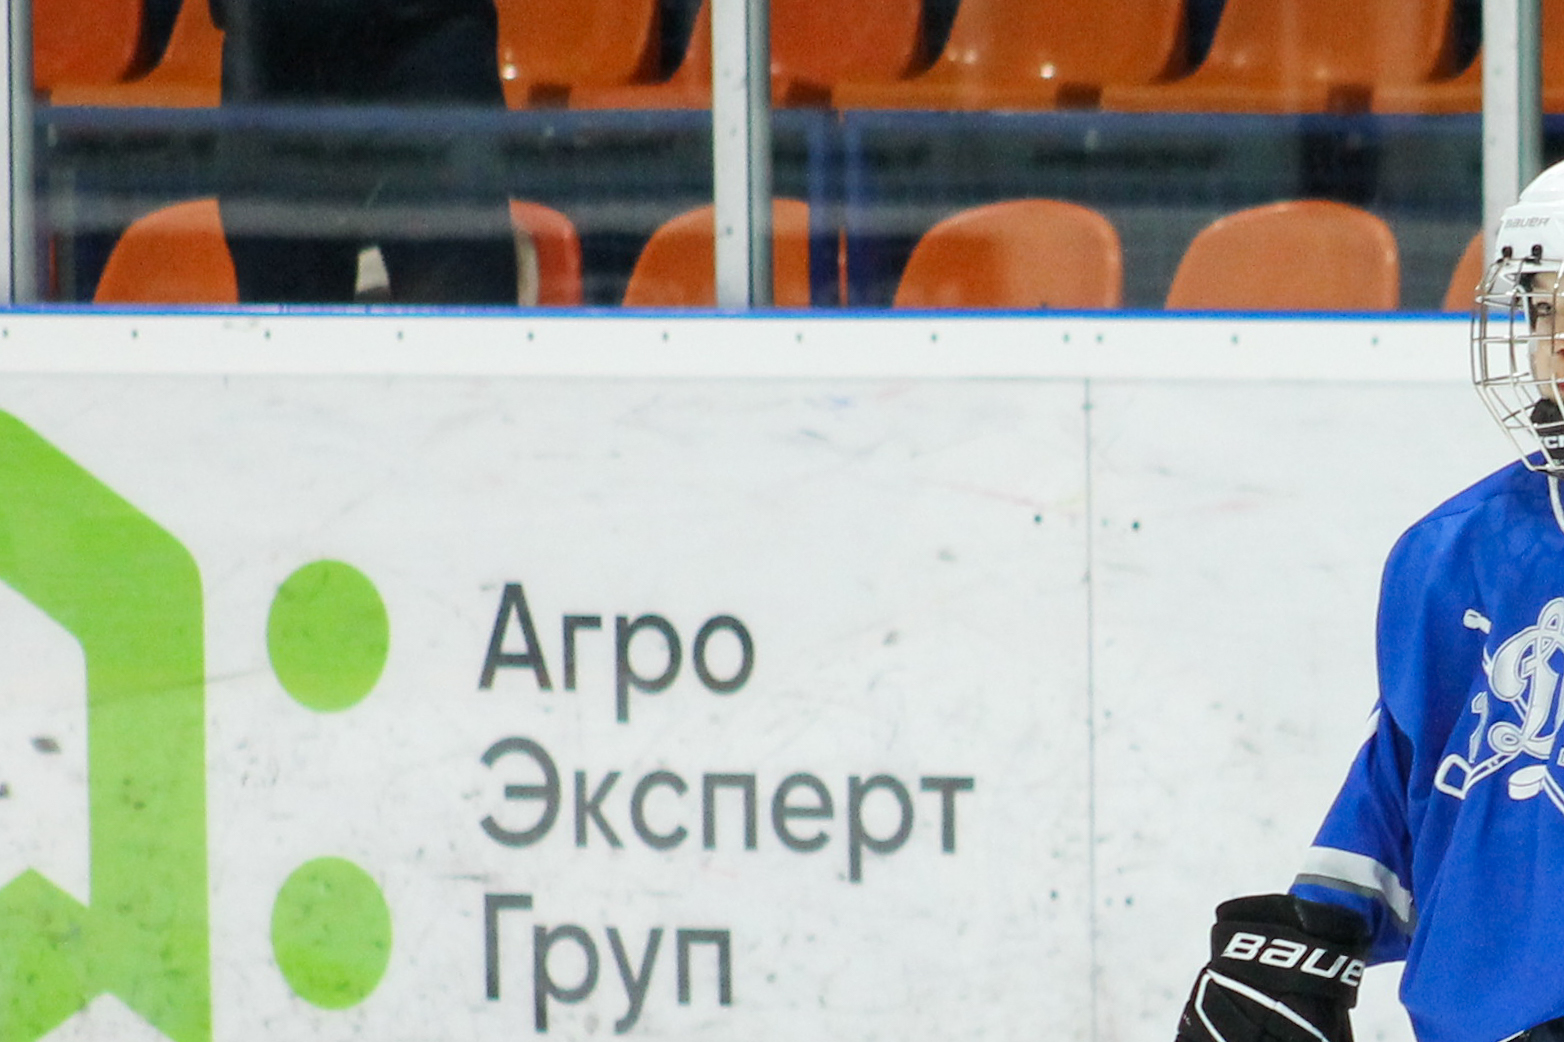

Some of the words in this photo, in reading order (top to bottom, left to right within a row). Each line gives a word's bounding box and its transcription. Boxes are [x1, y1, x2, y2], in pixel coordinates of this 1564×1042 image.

[478, 582, 755, 723] Агро
[479, 736, 975, 884] Эксперт
[483, 893, 734, 1034] Груп
[1220, 931, 1366, 987] BAUE
